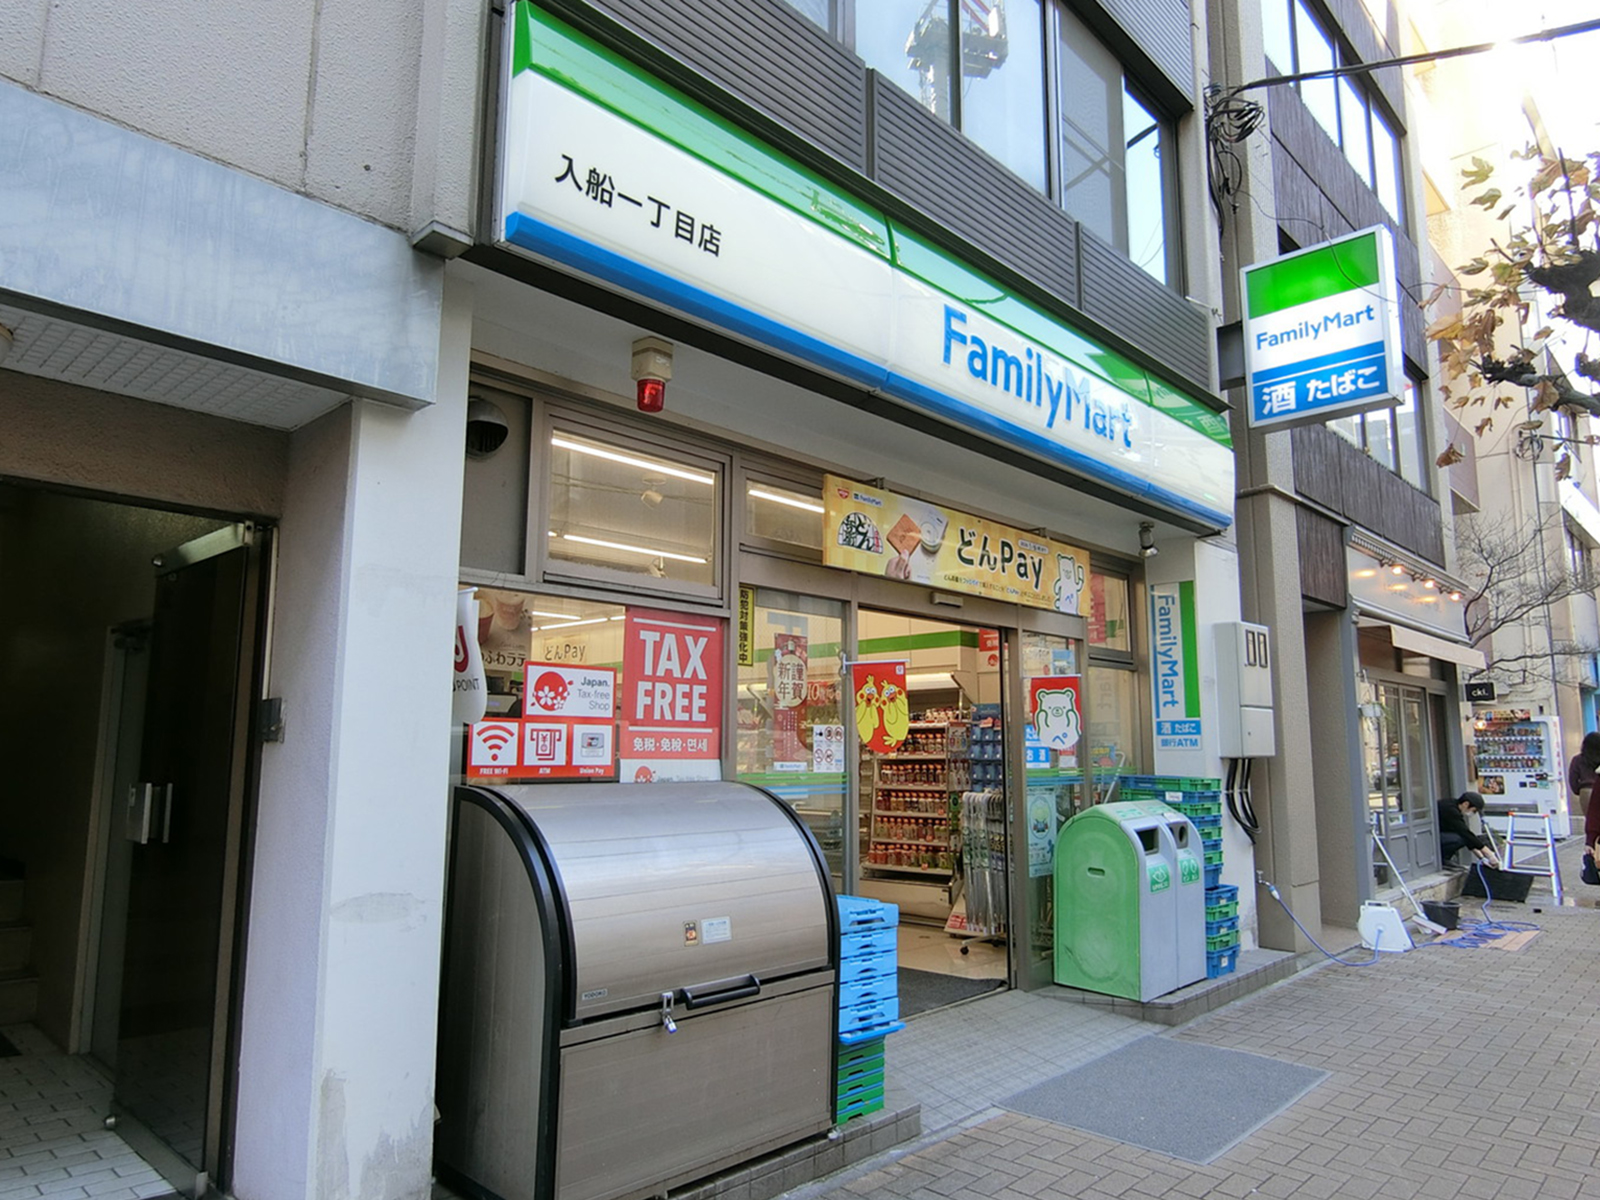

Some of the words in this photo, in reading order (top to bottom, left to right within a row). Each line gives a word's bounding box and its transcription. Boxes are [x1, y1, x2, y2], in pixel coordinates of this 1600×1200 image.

[555, 154, 721, 257] 入船一丁目店
[1256, 305, 1375, 350] FamilyMart
[943, 304, 1132, 448] FamilyMart
[1262, 381, 1297, 415] 酒
[1306, 366, 1380, 402] たばこ
[957, 528, 1043, 590] どんPay
[480, 650, 526, 667] ふわラテ
[544, 643, 586, 661] どんPay
[639, 630, 708, 680] TAX
[1157, 594, 1180, 708] FamilyMart
[456, 678, 480, 692] POINT
[577, 689, 610, 701] Tax-free
[581, 676, 610, 688] Japan.
[635, 681, 708, 722] FREE
[588, 701, 610, 711] Shop
